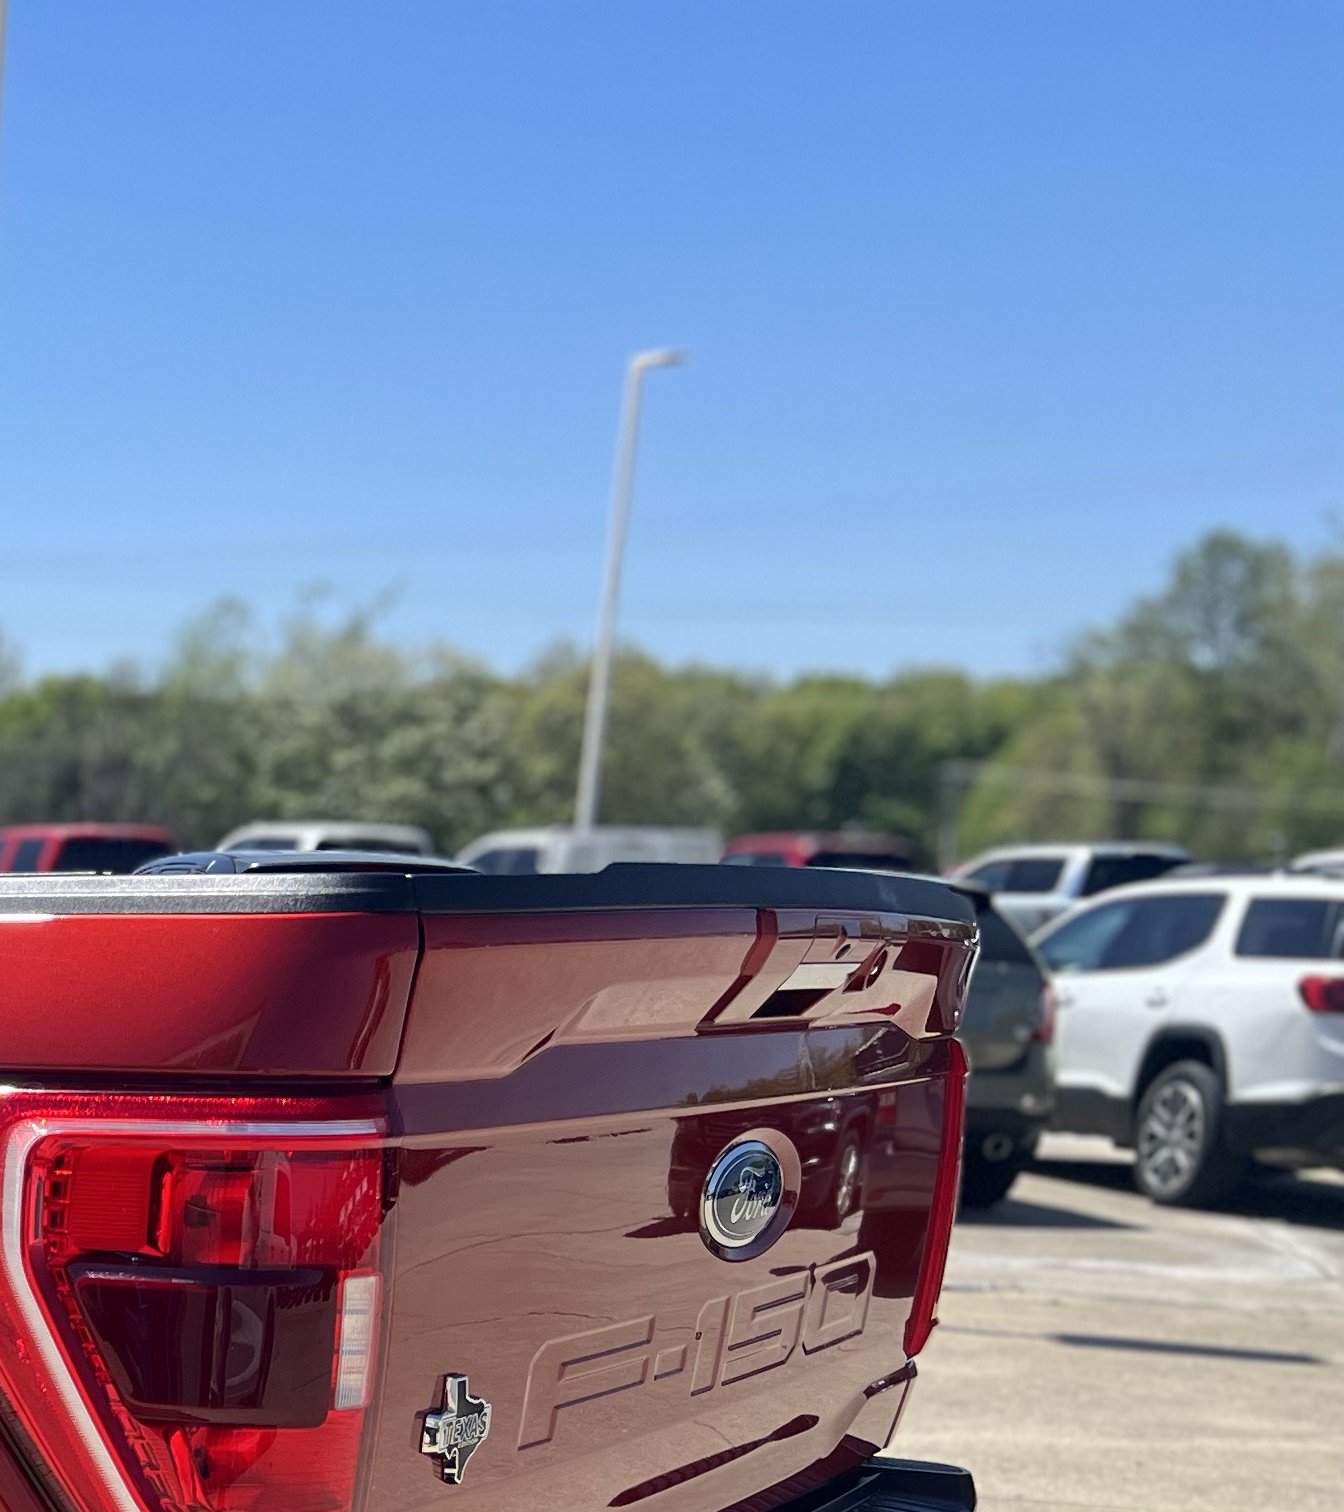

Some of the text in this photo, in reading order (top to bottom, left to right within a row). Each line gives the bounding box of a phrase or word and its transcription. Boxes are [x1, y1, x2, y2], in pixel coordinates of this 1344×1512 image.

[730, 1166, 774, 1224] Ford
[517, 1250, 877, 1451] F-150
[441, 1412, 488, 1447] TEXAS
